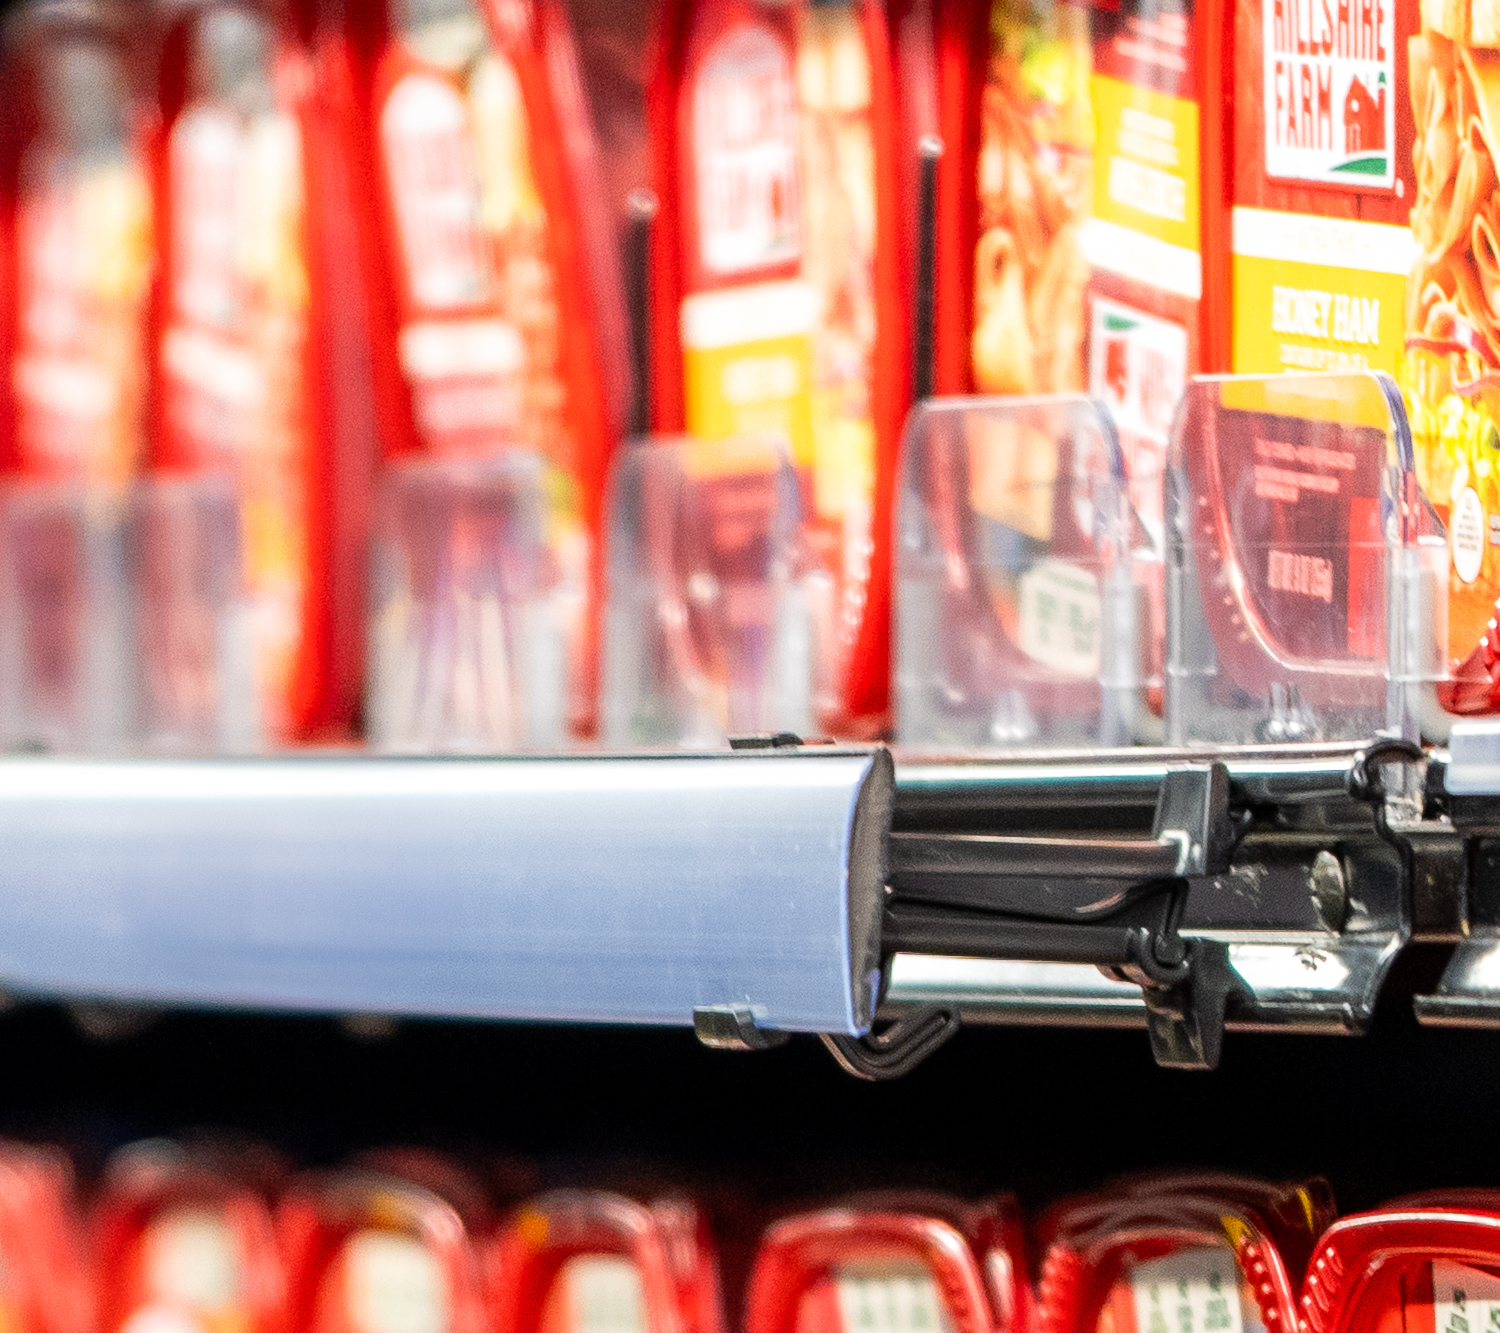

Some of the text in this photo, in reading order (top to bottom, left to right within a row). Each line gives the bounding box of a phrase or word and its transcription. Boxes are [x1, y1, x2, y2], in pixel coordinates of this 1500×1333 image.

[1273, 61, 1334, 151] FARM
[1271, 284, 1380, 345] HONEY HAM
